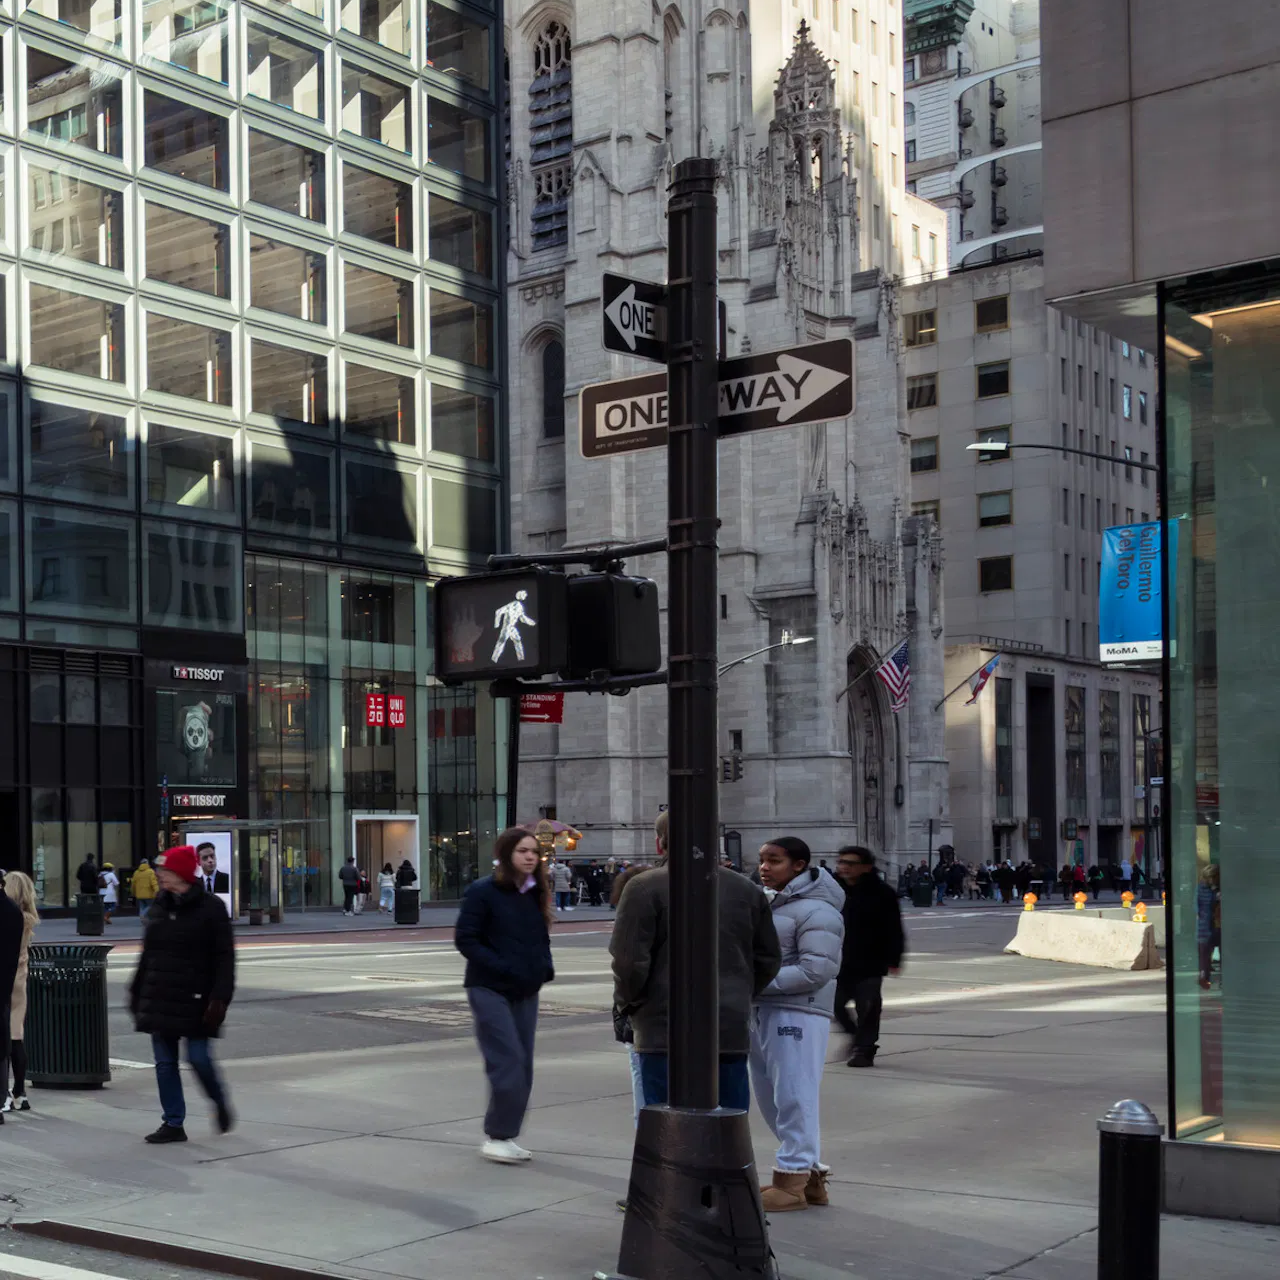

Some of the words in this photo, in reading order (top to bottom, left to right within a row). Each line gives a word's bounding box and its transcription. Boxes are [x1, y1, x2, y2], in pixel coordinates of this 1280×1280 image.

[619, 301, 656, 335] ONE
[604, 395, 668, 432] ONE
[725, 369, 813, 411] WAY
[1118, 528, 1137, 552] del
[1117, 554, 1135, 590] Toro
[1138, 526, 1158, 603] Guillermo
[1106, 646, 1139, 655] MoMA
[187, 668, 225, 681] TISSOT
[389, 698, 404, 711] UNI
[525, 694, 557, 702] STANDING
[389, 711, 405, 726] QLO
[189, 794, 226, 807] TISSOT
